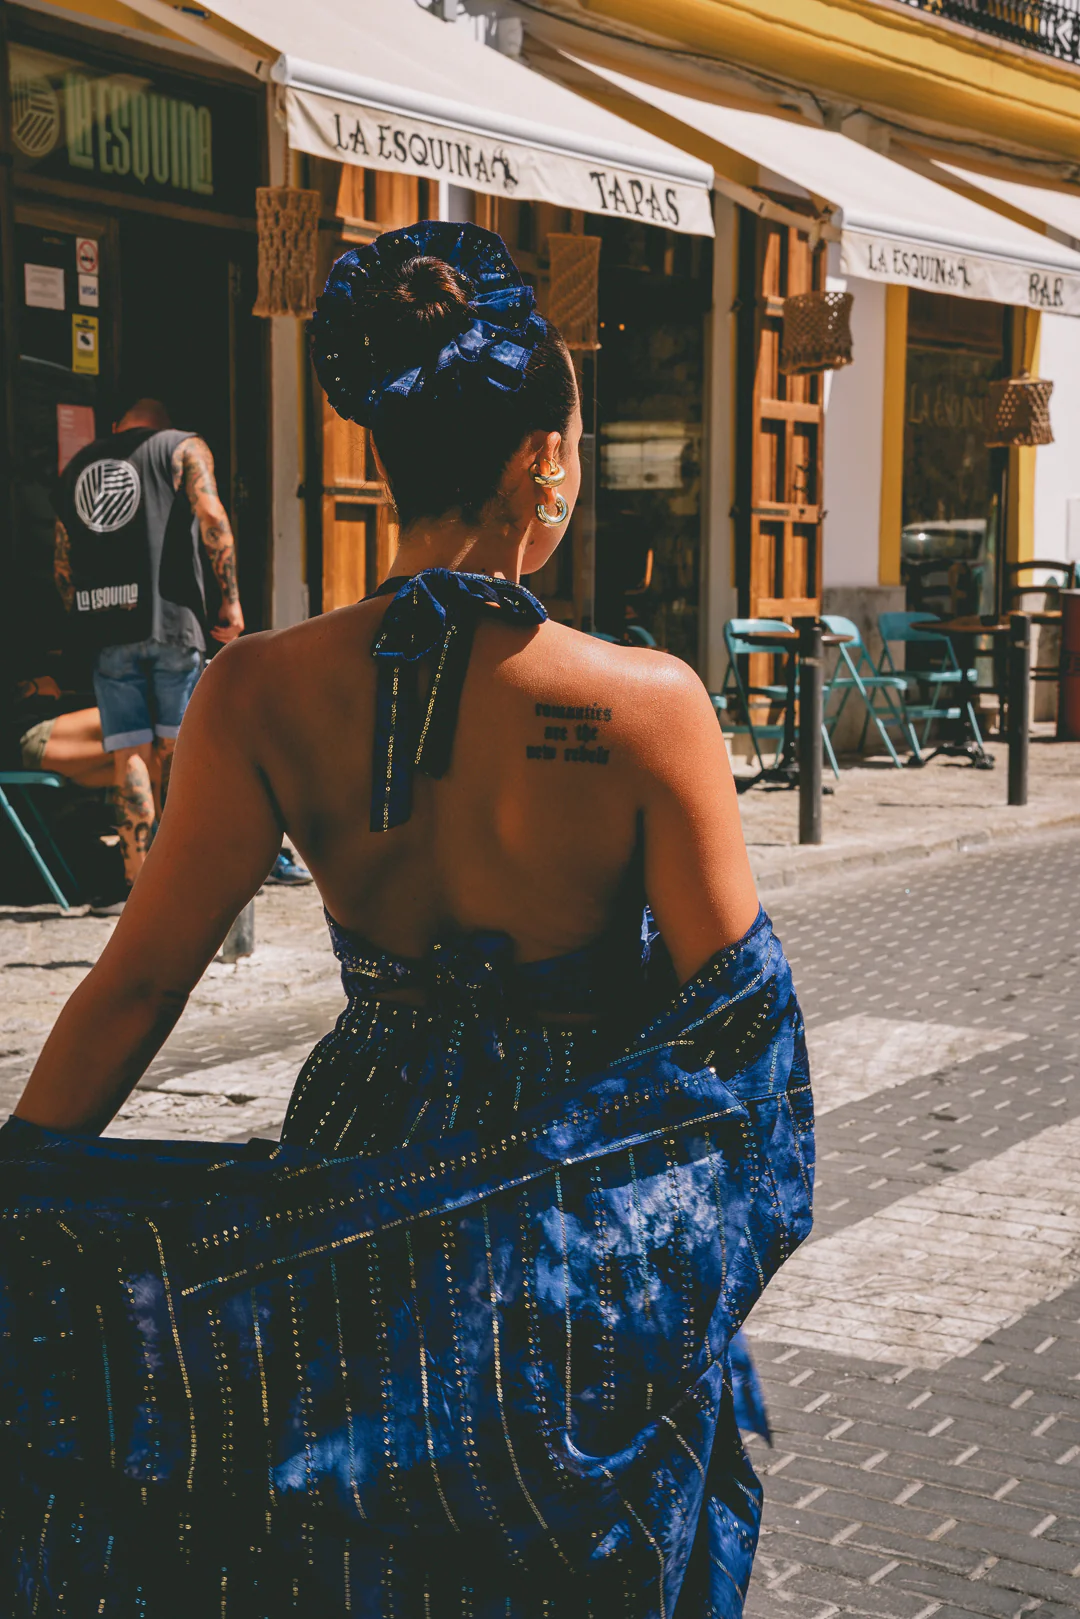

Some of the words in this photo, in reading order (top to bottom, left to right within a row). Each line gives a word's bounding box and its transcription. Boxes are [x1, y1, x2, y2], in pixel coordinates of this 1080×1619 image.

[64, 72, 94, 170] LA
[98, 82, 213, 195] ESQUINA
[333, 113, 369, 156] LA
[377, 124, 491, 183] ESQUINA
[589, 171, 680, 226] TAPAS
[868, 244, 889, 274] LA
[893, 248, 959, 287] ESQUINA
[1028, 272, 1064, 307] BAR
